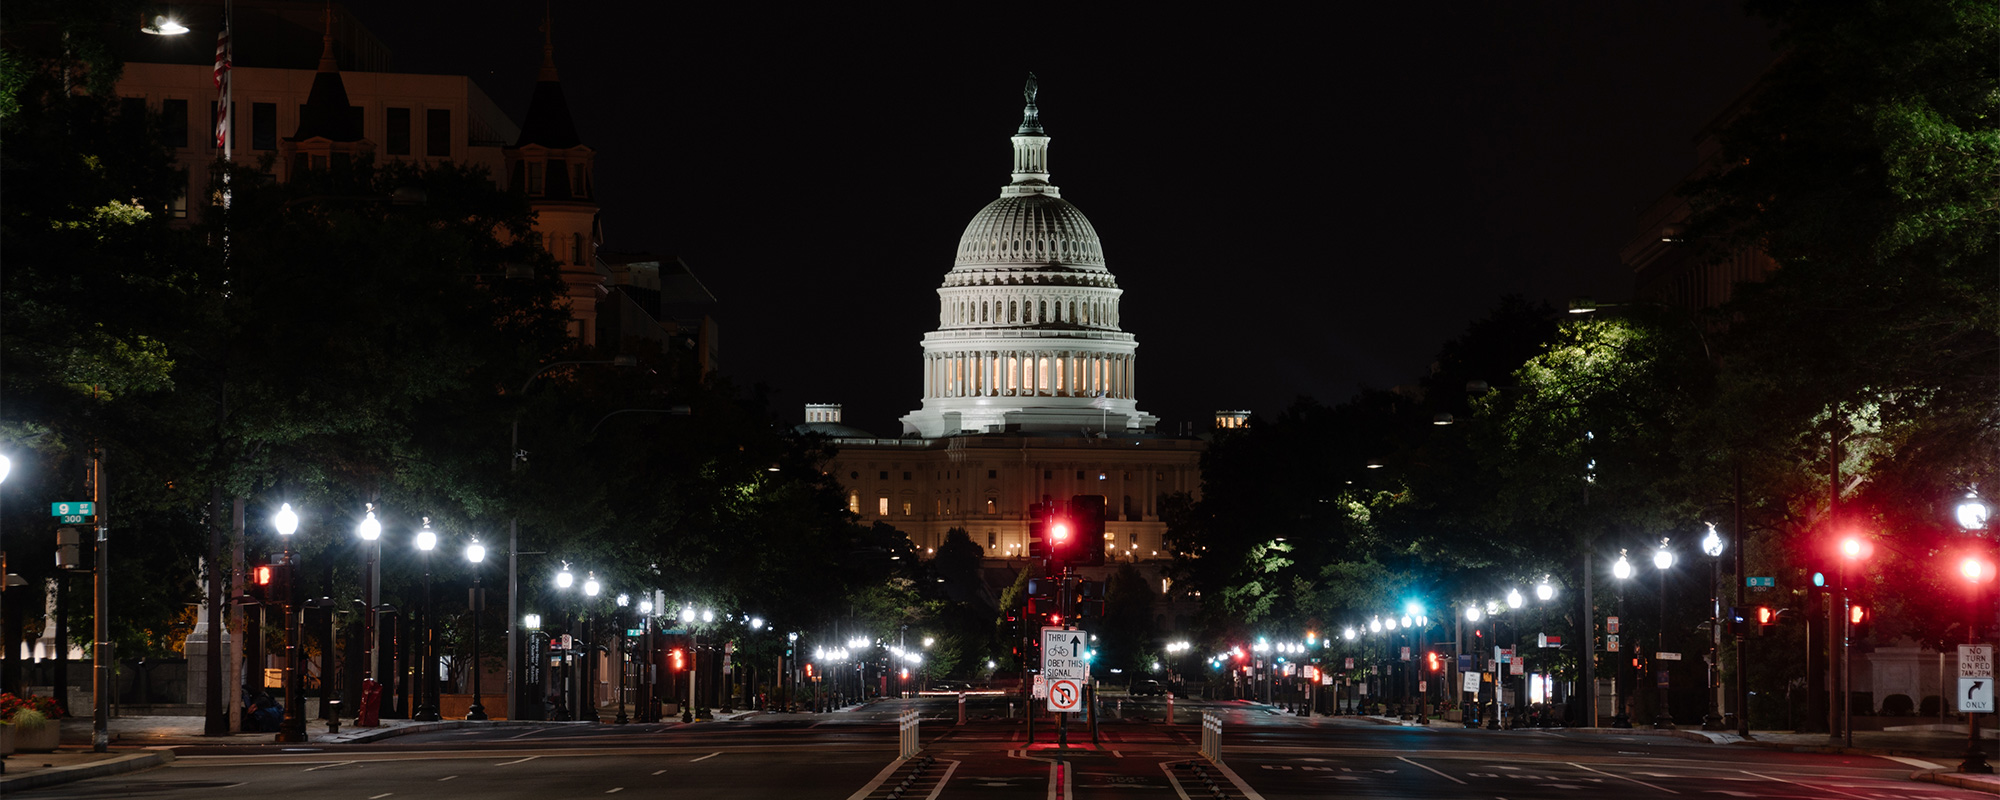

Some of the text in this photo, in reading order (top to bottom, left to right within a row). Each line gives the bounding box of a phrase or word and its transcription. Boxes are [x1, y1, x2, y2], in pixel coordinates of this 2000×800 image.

[59, 504, 69, 514] 9
[1750, 578, 1757, 586] 9
[1048, 634, 1066, 642] THRU
[1068, 660, 1083, 668] THIS
[1047, 669, 1071, 677] SIGNAL
